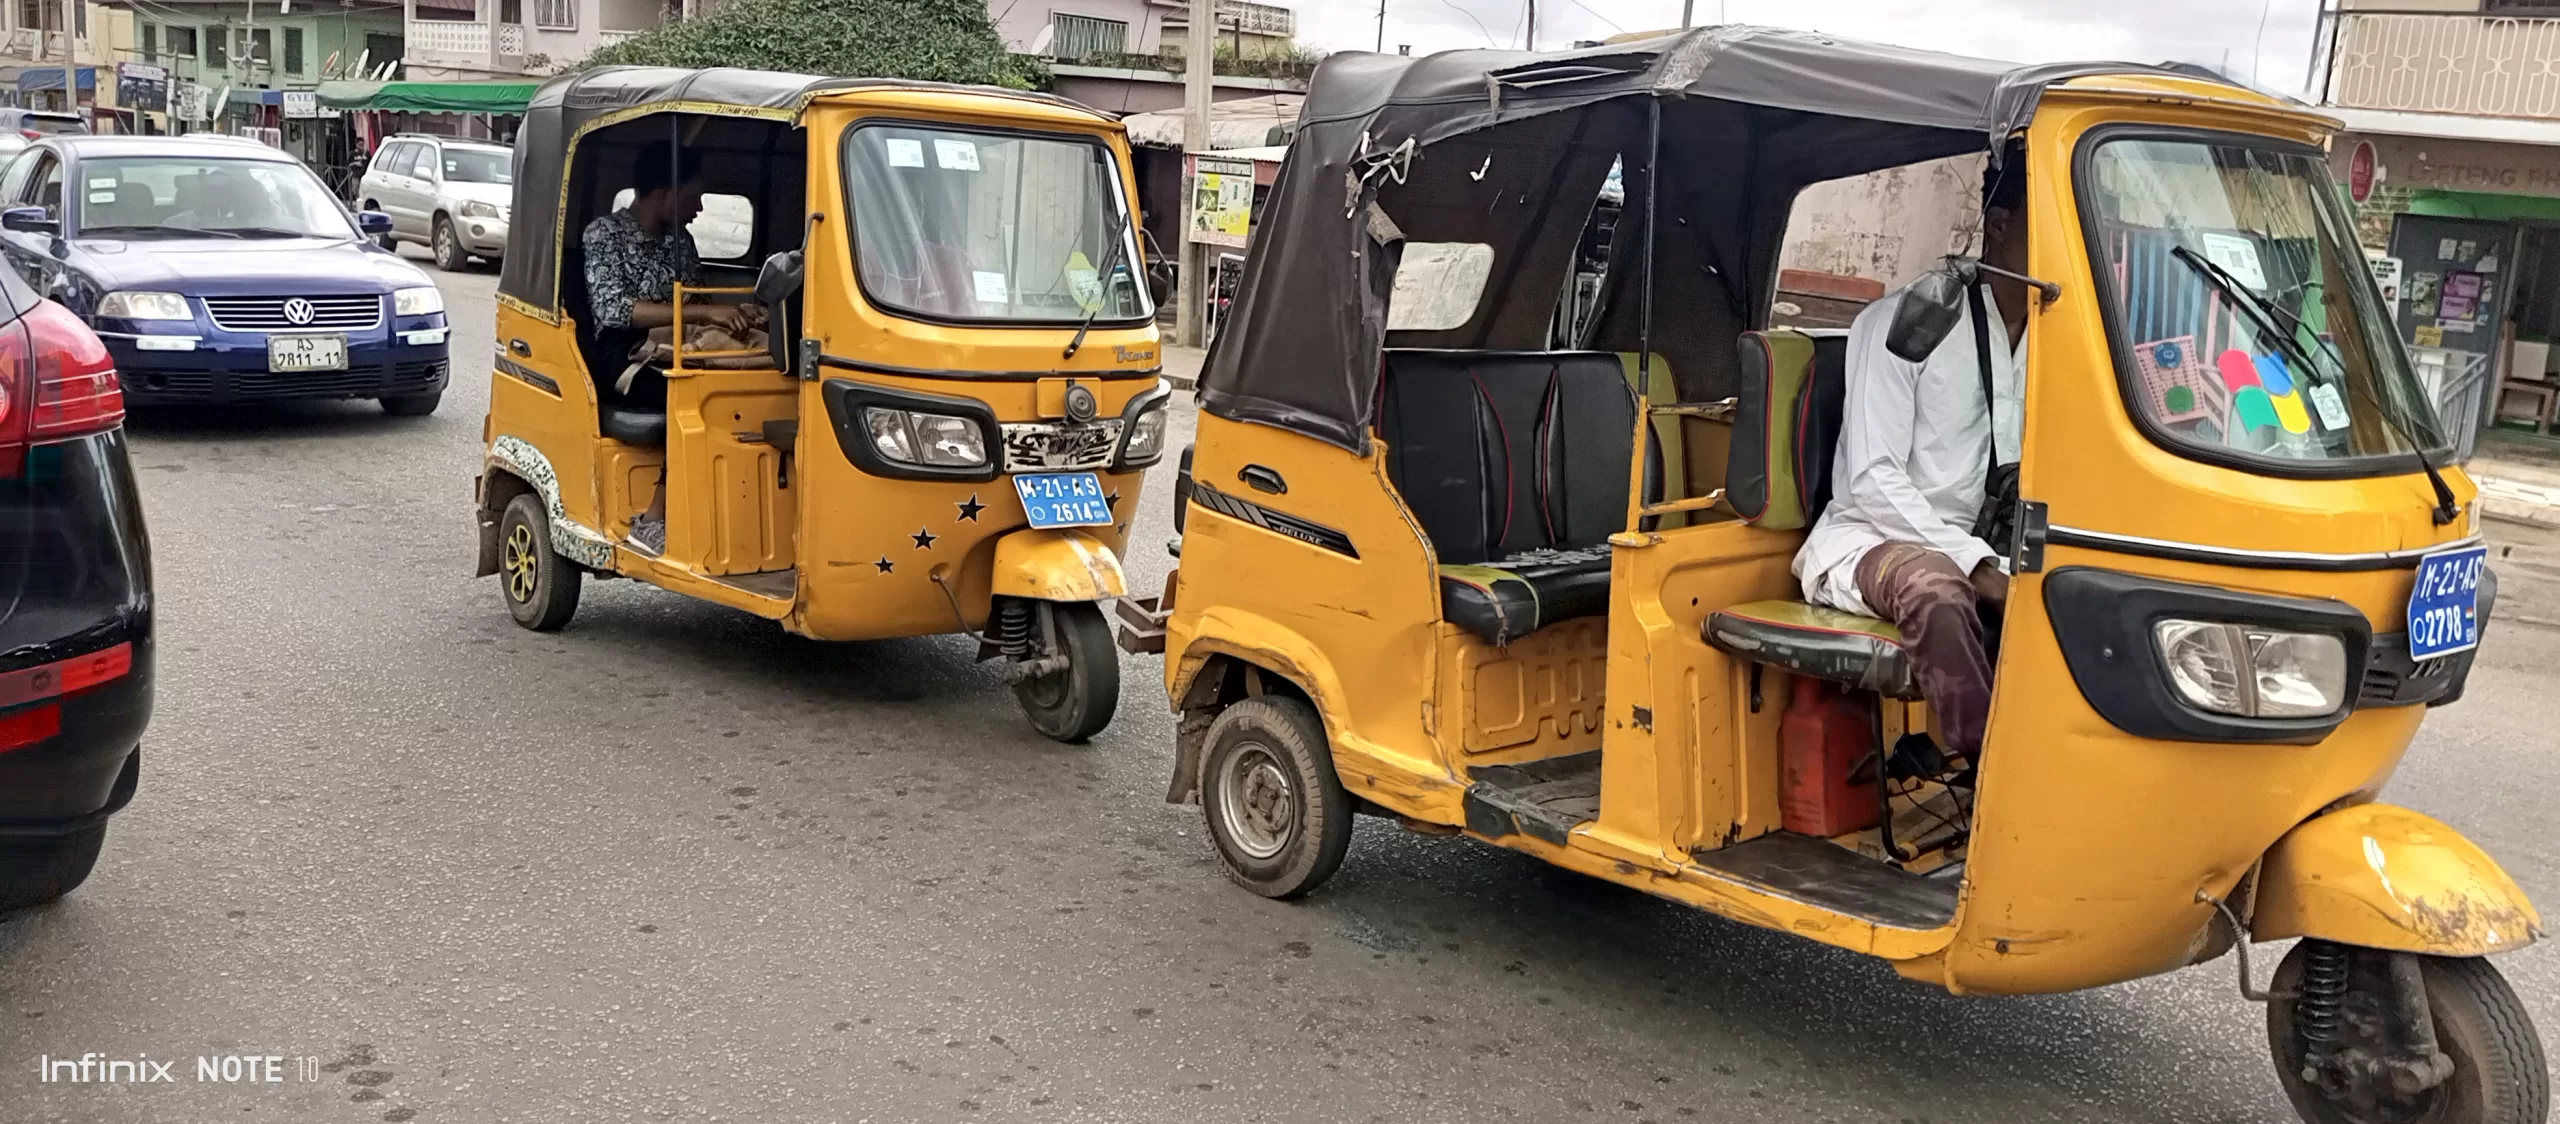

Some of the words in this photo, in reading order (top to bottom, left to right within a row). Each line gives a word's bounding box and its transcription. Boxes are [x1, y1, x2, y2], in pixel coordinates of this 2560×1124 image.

[715, 105, 759, 116] OFF-WHITE
[297, 338, 314, 351] AS
[1052, 502, 1093, 522] 2614
[1279, 525, 1323, 546] DELUXE
[2420, 555, 2484, 599] M-21-AS
[2425, 604, 2462, 647] 2798
